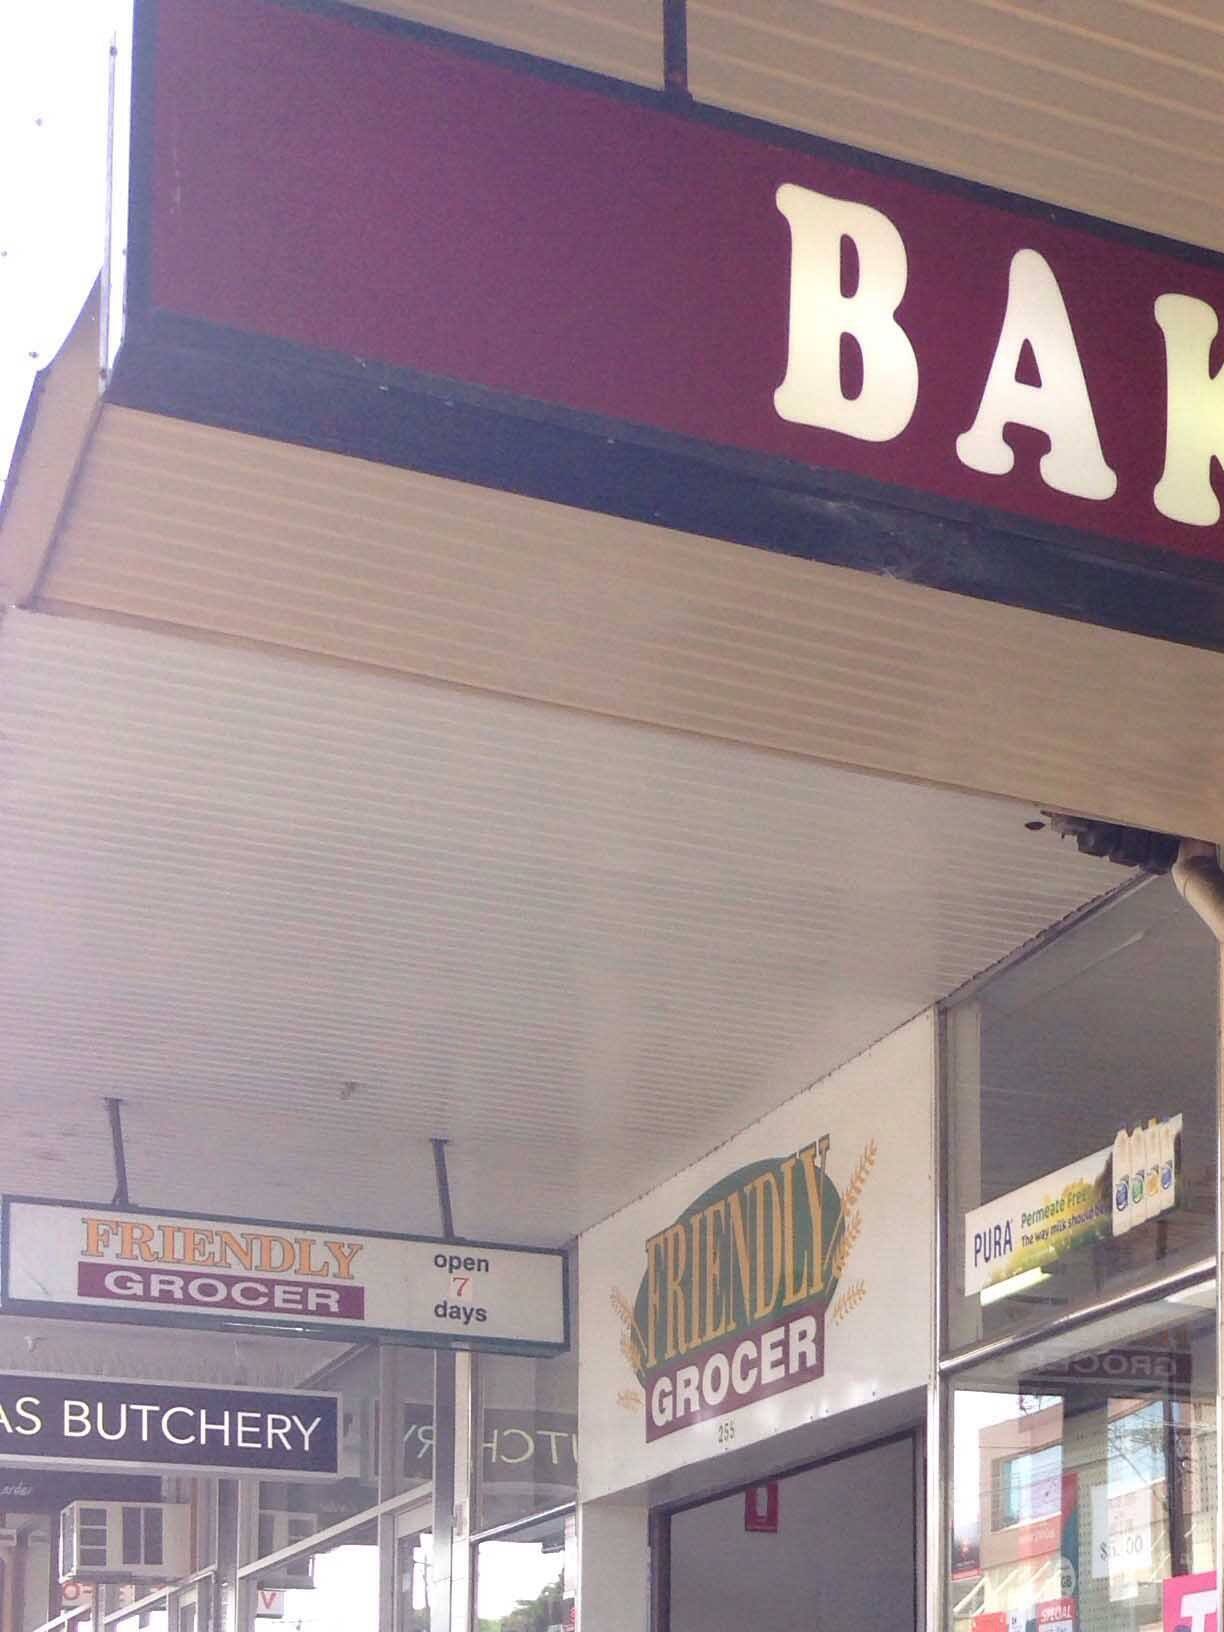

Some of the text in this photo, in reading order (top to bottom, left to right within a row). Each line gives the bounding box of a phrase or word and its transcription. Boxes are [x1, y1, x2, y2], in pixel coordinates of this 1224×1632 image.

[1021, 1191, 1089, 1229] Permeate Free
[81, 1217, 365, 1279] FRIENDLY
[646, 1134, 830, 1367] FRIENDLY
[974, 1219, 1013, 1268] PURA
[1022, 1232, 1034, 1248] The
[1050, 1220, 1067, 1236] milk
[433, 1253, 490, 1274] open
[104, 1270, 341, 1312] GROCER
[451, 1277, 468, 1297] 7
[434, 1301, 488, 1325] days
[652, 1316, 818, 1427] GROCER
[63, 1399, 321, 1451] BUTCHERY
[718, 1421, 736, 1443] 255
